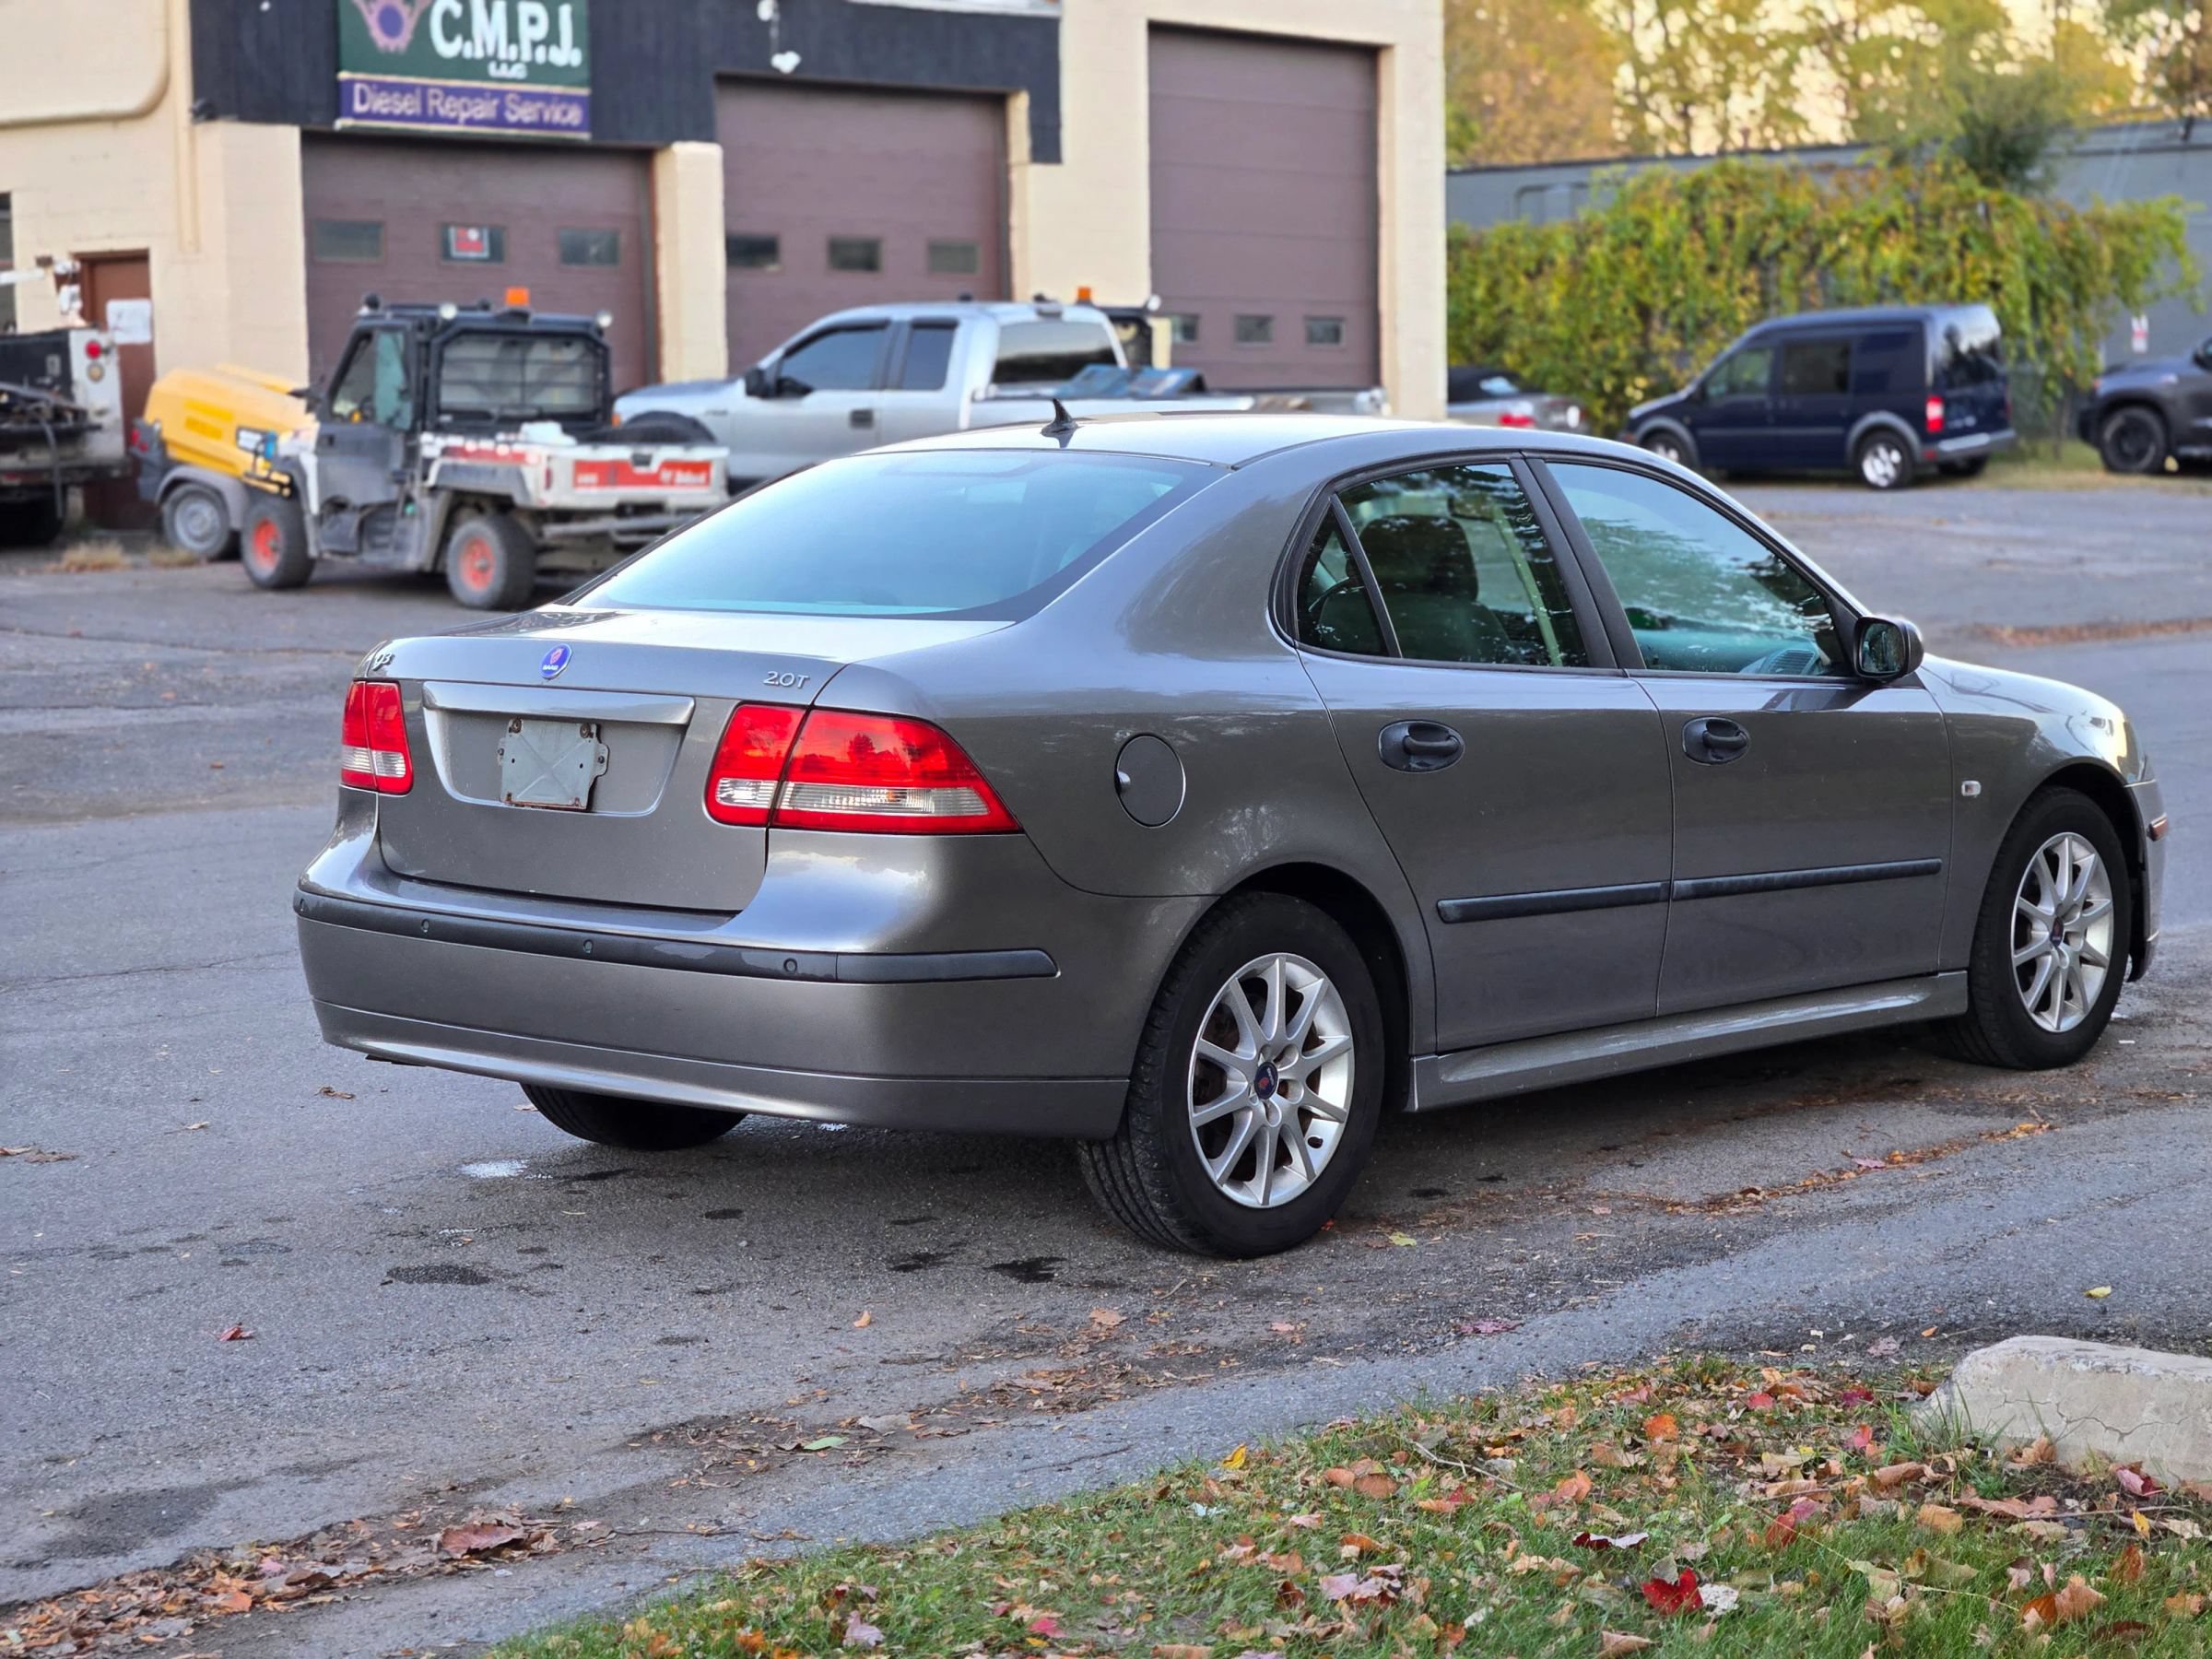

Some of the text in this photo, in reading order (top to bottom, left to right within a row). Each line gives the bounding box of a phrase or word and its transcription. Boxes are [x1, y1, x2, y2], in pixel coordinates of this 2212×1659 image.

[488, 61, 527, 79] LLC
[352, 82, 582, 125] Diesel Repair Service
[763, 670, 809, 688] 2.0T
